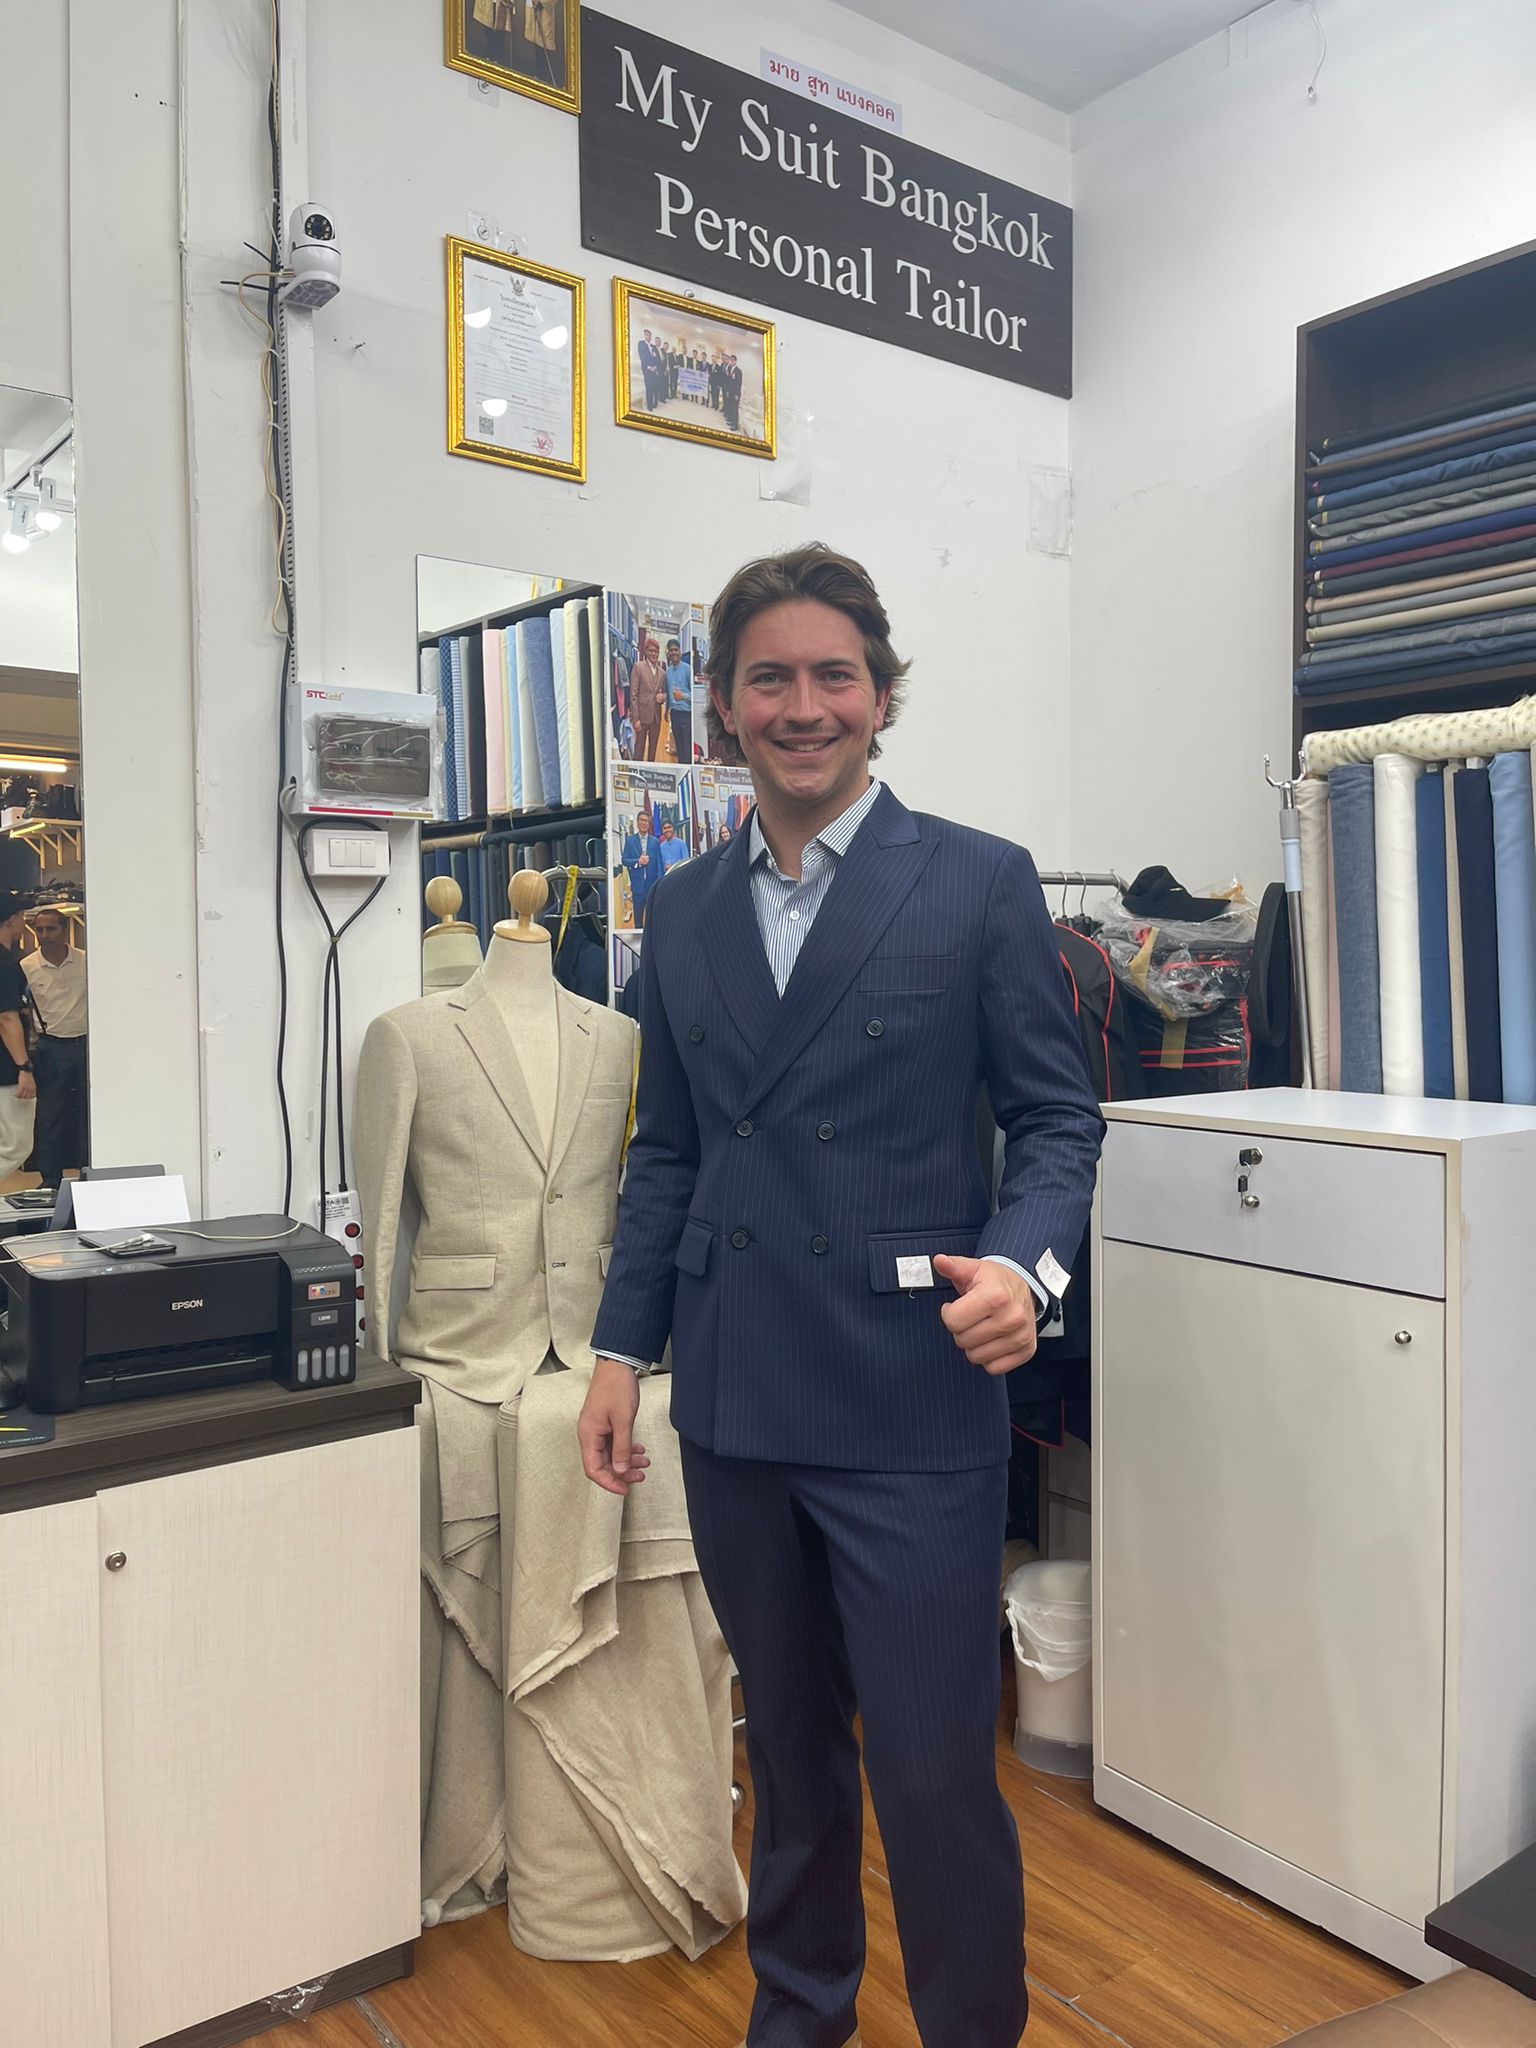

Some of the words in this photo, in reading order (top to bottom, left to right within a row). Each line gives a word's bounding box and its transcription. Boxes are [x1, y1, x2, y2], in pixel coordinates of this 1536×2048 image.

[769, 59, 800, 83] มาย
[807, 75, 830, 97] สูท
[836, 86, 895, 122] แบงคอค
[613, 45, 713, 152] My
[739, 98, 841, 190] Suit
[860, 143, 1055, 270] Bangkok
[653, 171, 877, 305] Personal
[896, 258, 1027, 352] Tailor
[306, 690, 327, 700] STC
[171, 1299, 204, 1311] EPSON
